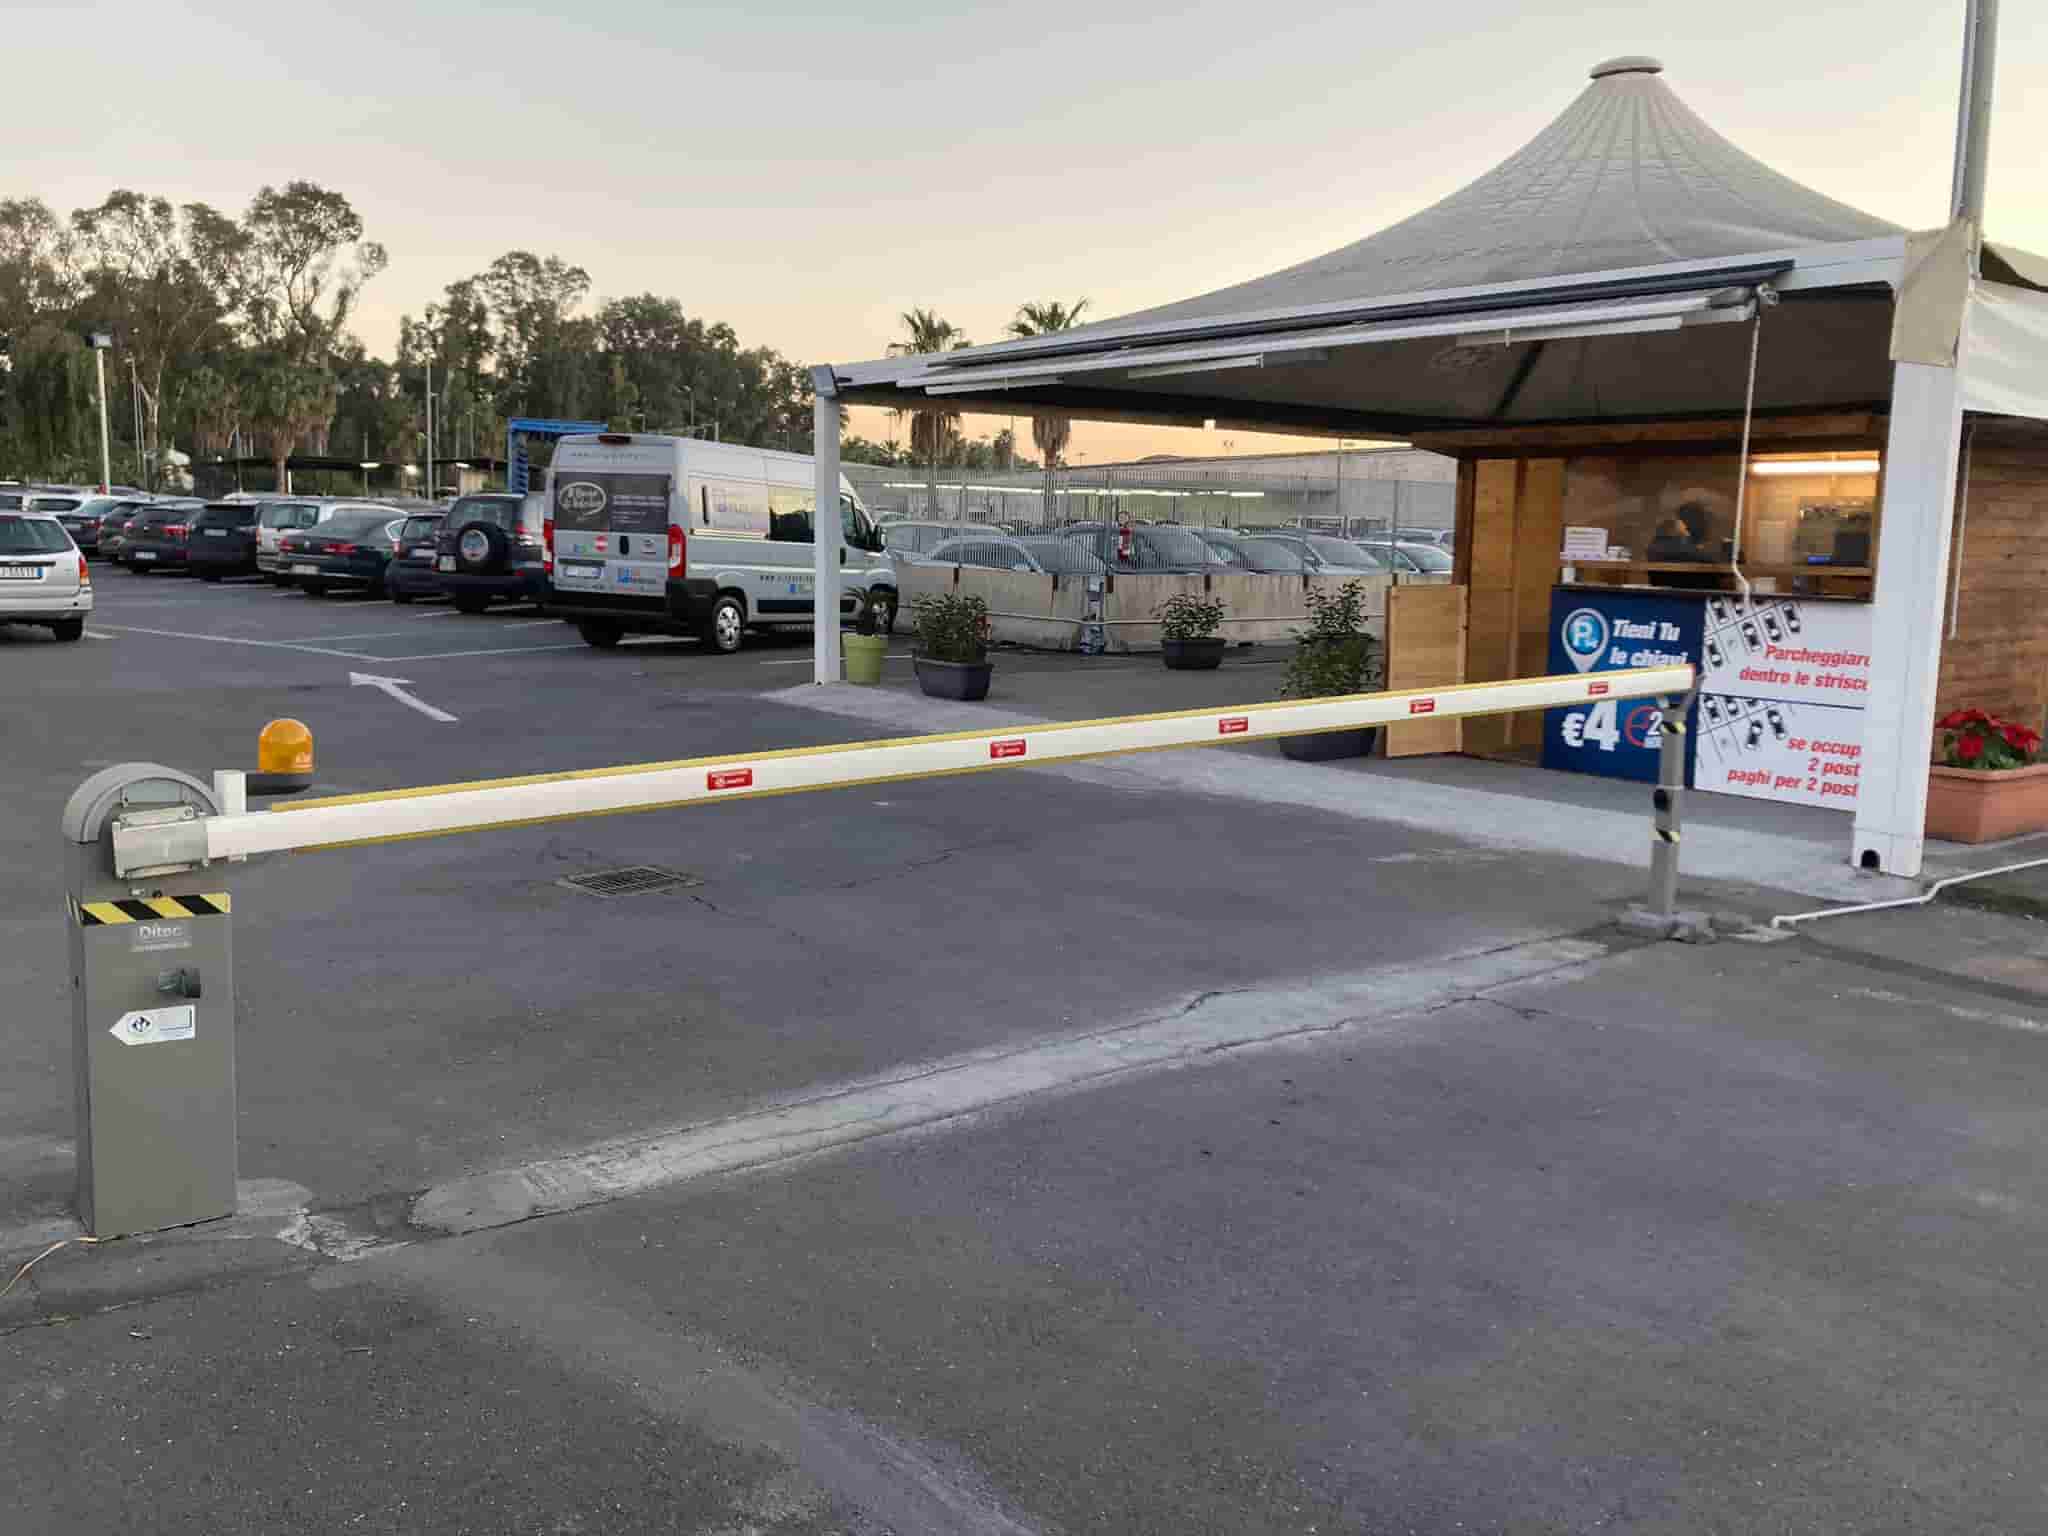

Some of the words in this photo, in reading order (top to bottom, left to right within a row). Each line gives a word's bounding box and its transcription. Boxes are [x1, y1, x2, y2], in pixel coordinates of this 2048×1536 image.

[1612, 619, 1657, 639] Tieni
[1658, 622, 1681, 641] Tu
[1609, 647, 1627, 665] le
[1739, 665, 1791, 685] dentro
[1793, 670, 1810, 686] le
[1787, 737, 1807, 751] se
[1807, 757, 1820, 772] 2
[1727, 769, 1771, 786] paghi
[1774, 775, 1803, 790] per
[1807, 777, 1818, 791] 2
